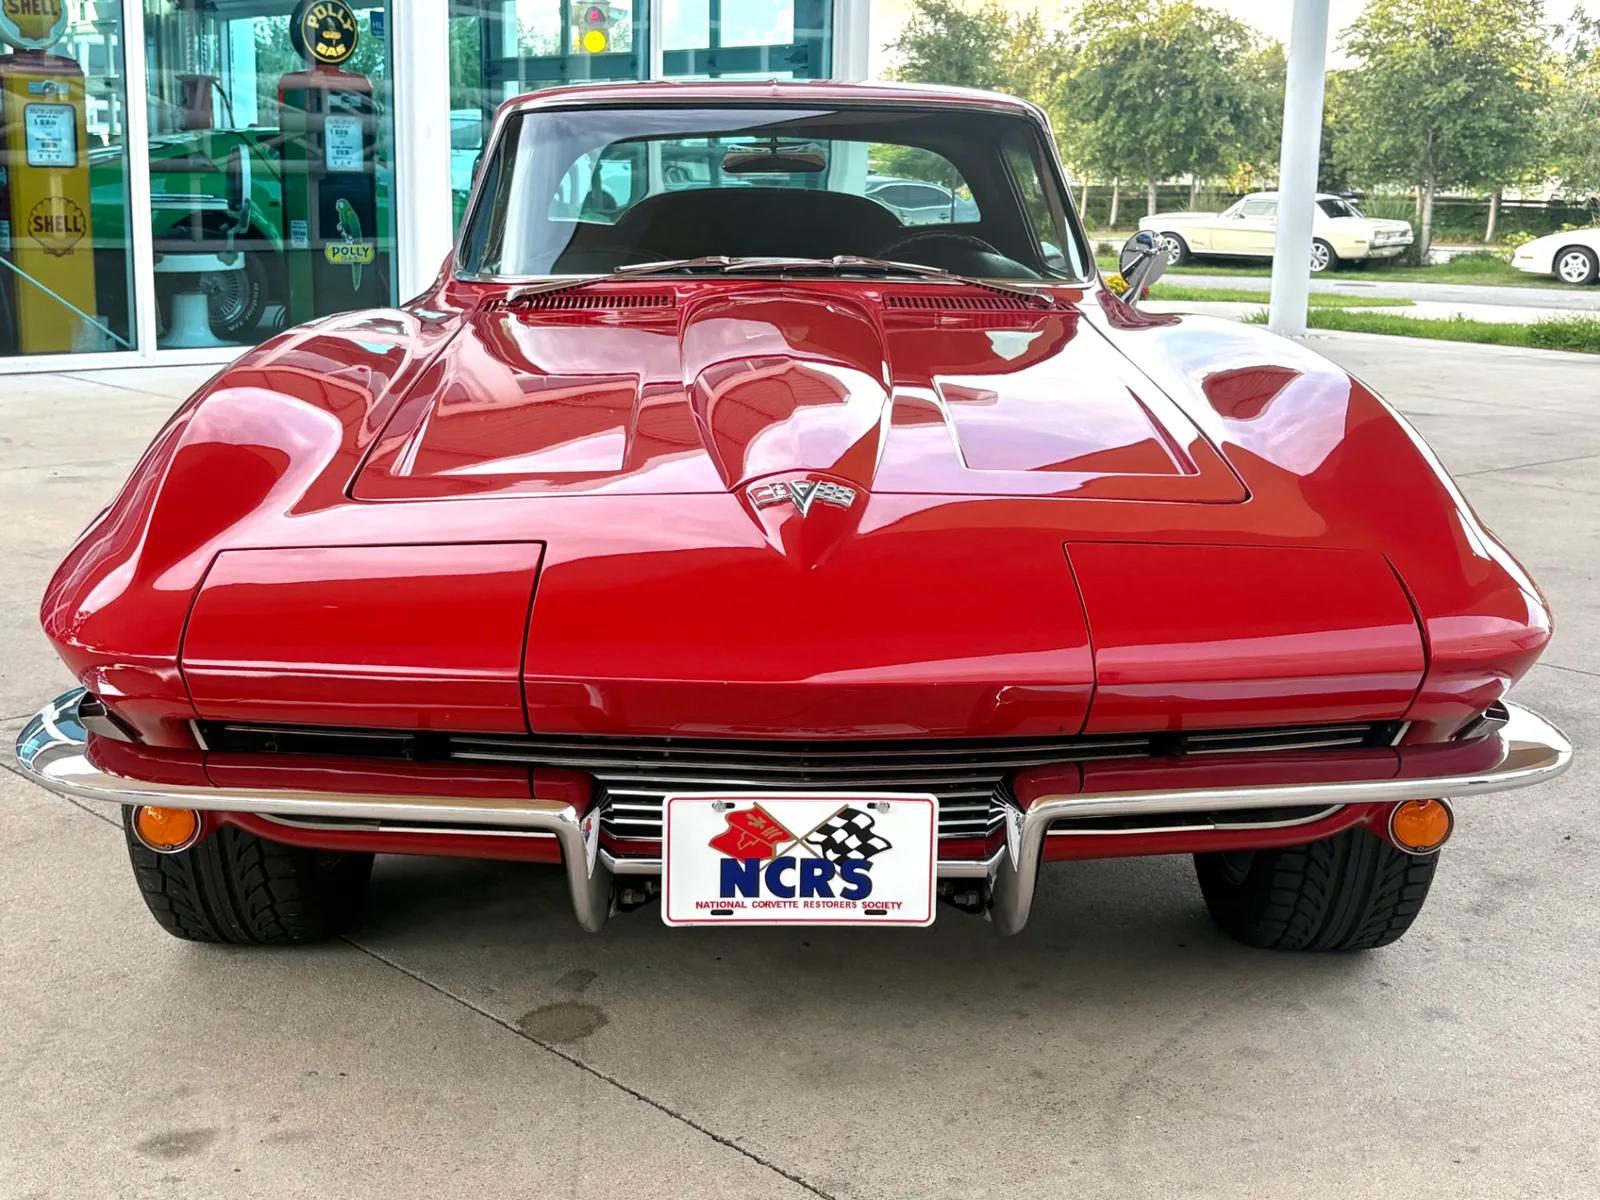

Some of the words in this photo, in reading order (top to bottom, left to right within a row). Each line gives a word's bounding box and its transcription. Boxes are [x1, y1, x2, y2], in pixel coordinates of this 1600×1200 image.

[8, 0, 58, 16] SHELL
[307, 3, 353, 31] POLLY
[316, 42, 346, 57] GAS
[33, 215, 81, 232] SHELL
[332, 246, 369, 258] POLLY
[720, 856, 873, 900] NCRS
[695, 901, 747, 909] NATIONAL
[752, 901, 798, 909] CORVETTE
[803, 900, 857, 909] RESTORERS
[861, 901, 902, 909] SOCIETY
